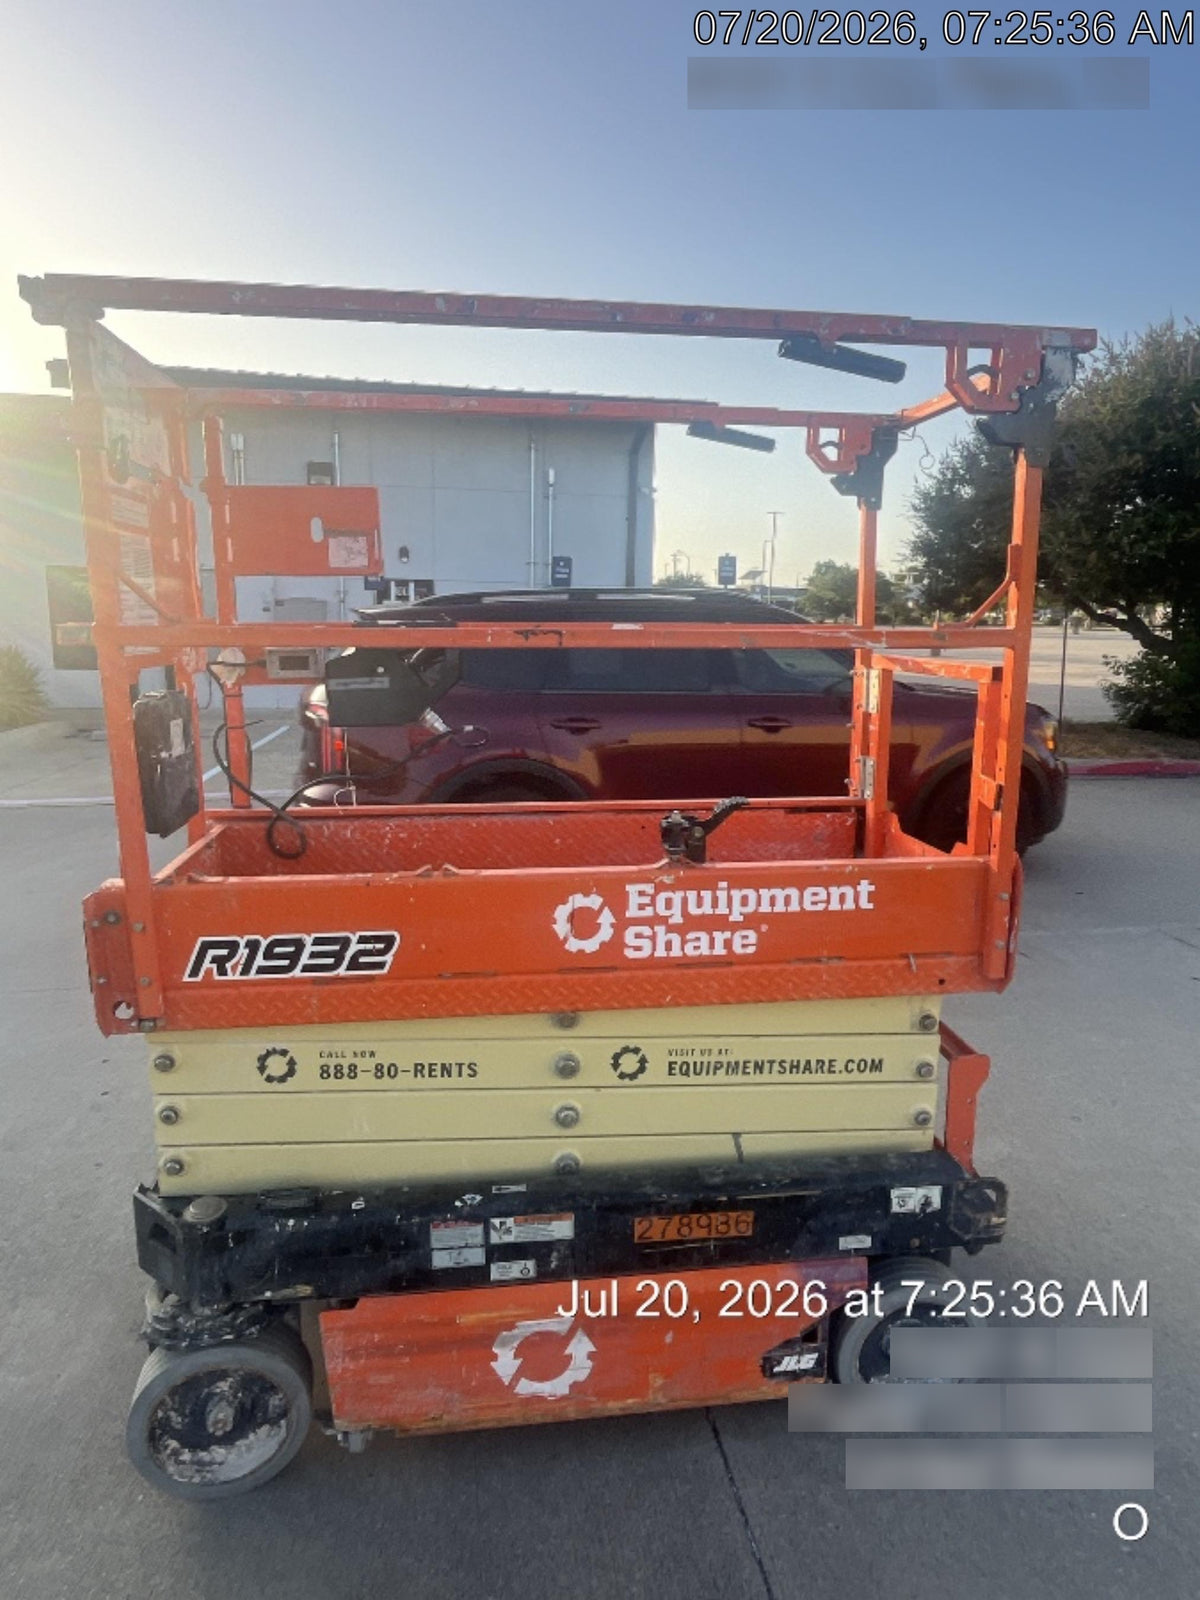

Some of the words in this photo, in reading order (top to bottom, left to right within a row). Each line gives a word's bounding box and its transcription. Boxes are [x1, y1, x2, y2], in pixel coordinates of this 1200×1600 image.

[624, 879, 876, 924] Equipment
[182, 930, 400, 982] R1932
[623, 923, 758, 959] Share
[319, 1062, 478, 1080] 888-80-RENTS
[667, 1057, 884, 1078] EQUIPMENTSHARE.COM
